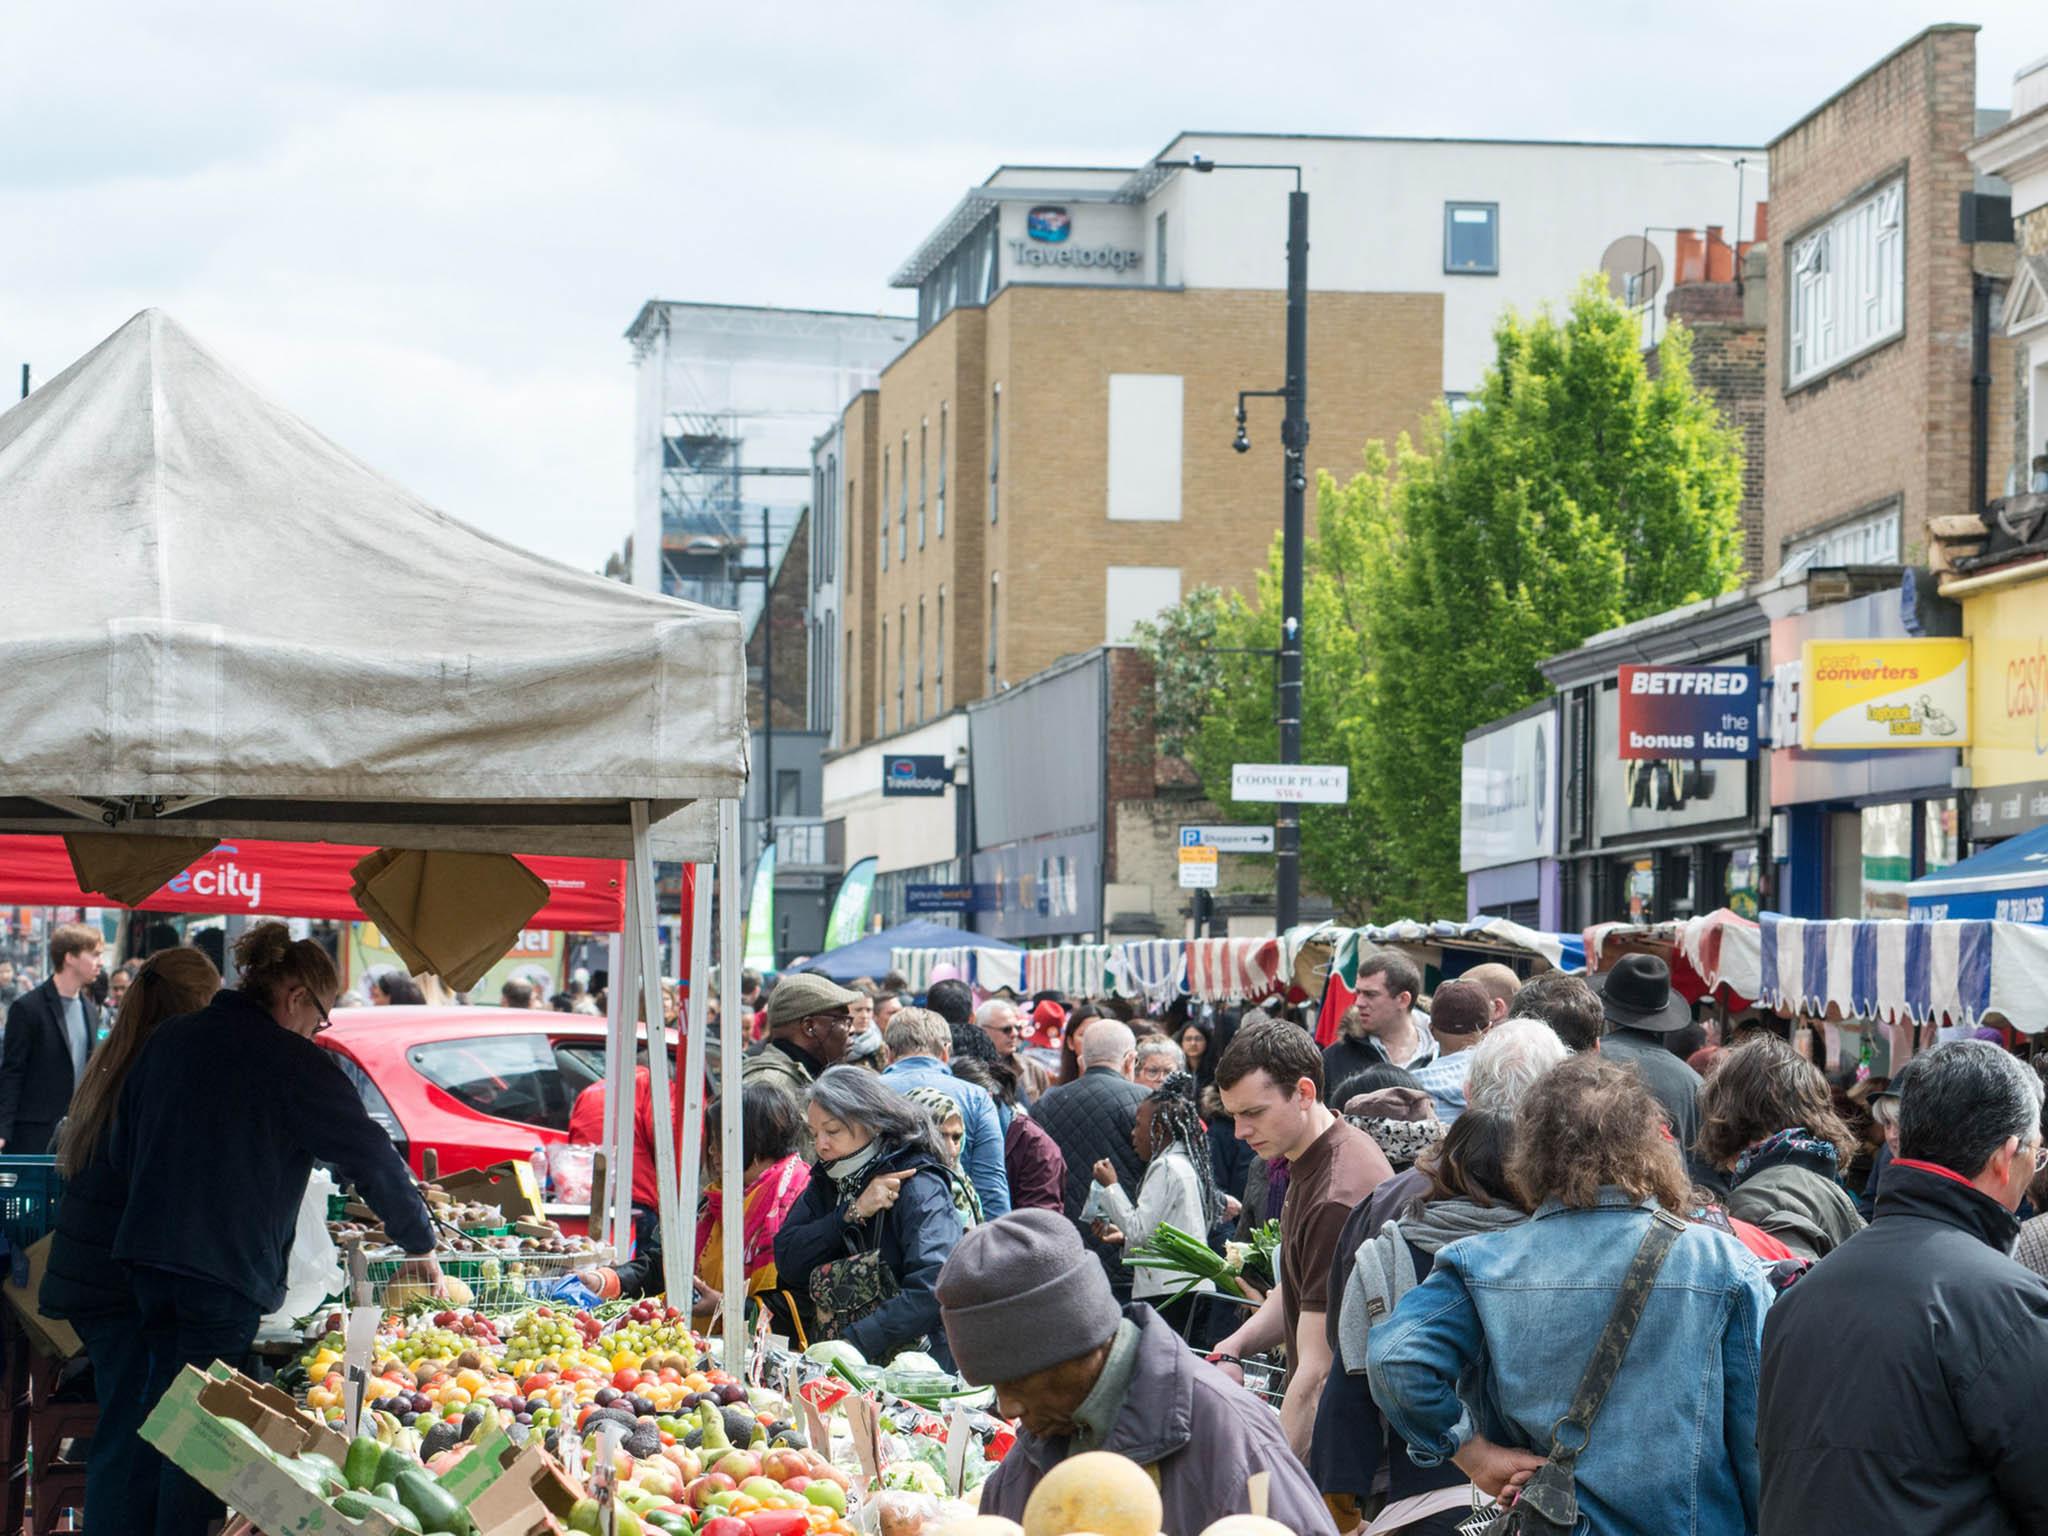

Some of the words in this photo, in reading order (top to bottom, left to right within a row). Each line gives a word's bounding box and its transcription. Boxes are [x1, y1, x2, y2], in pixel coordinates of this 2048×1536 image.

[1009, 239, 1142, 274] Travelodge
[1819, 654, 1860, 668] cash
[1816, 664, 1919, 681] converters
[1631, 672, 1748, 695] BETFRED
[1721, 713, 1749, 731] the
[1629, 731, 1695, 749] bonus
[1703, 731, 1749, 752] king
[1203, 833, 1248, 845] Shoppers
